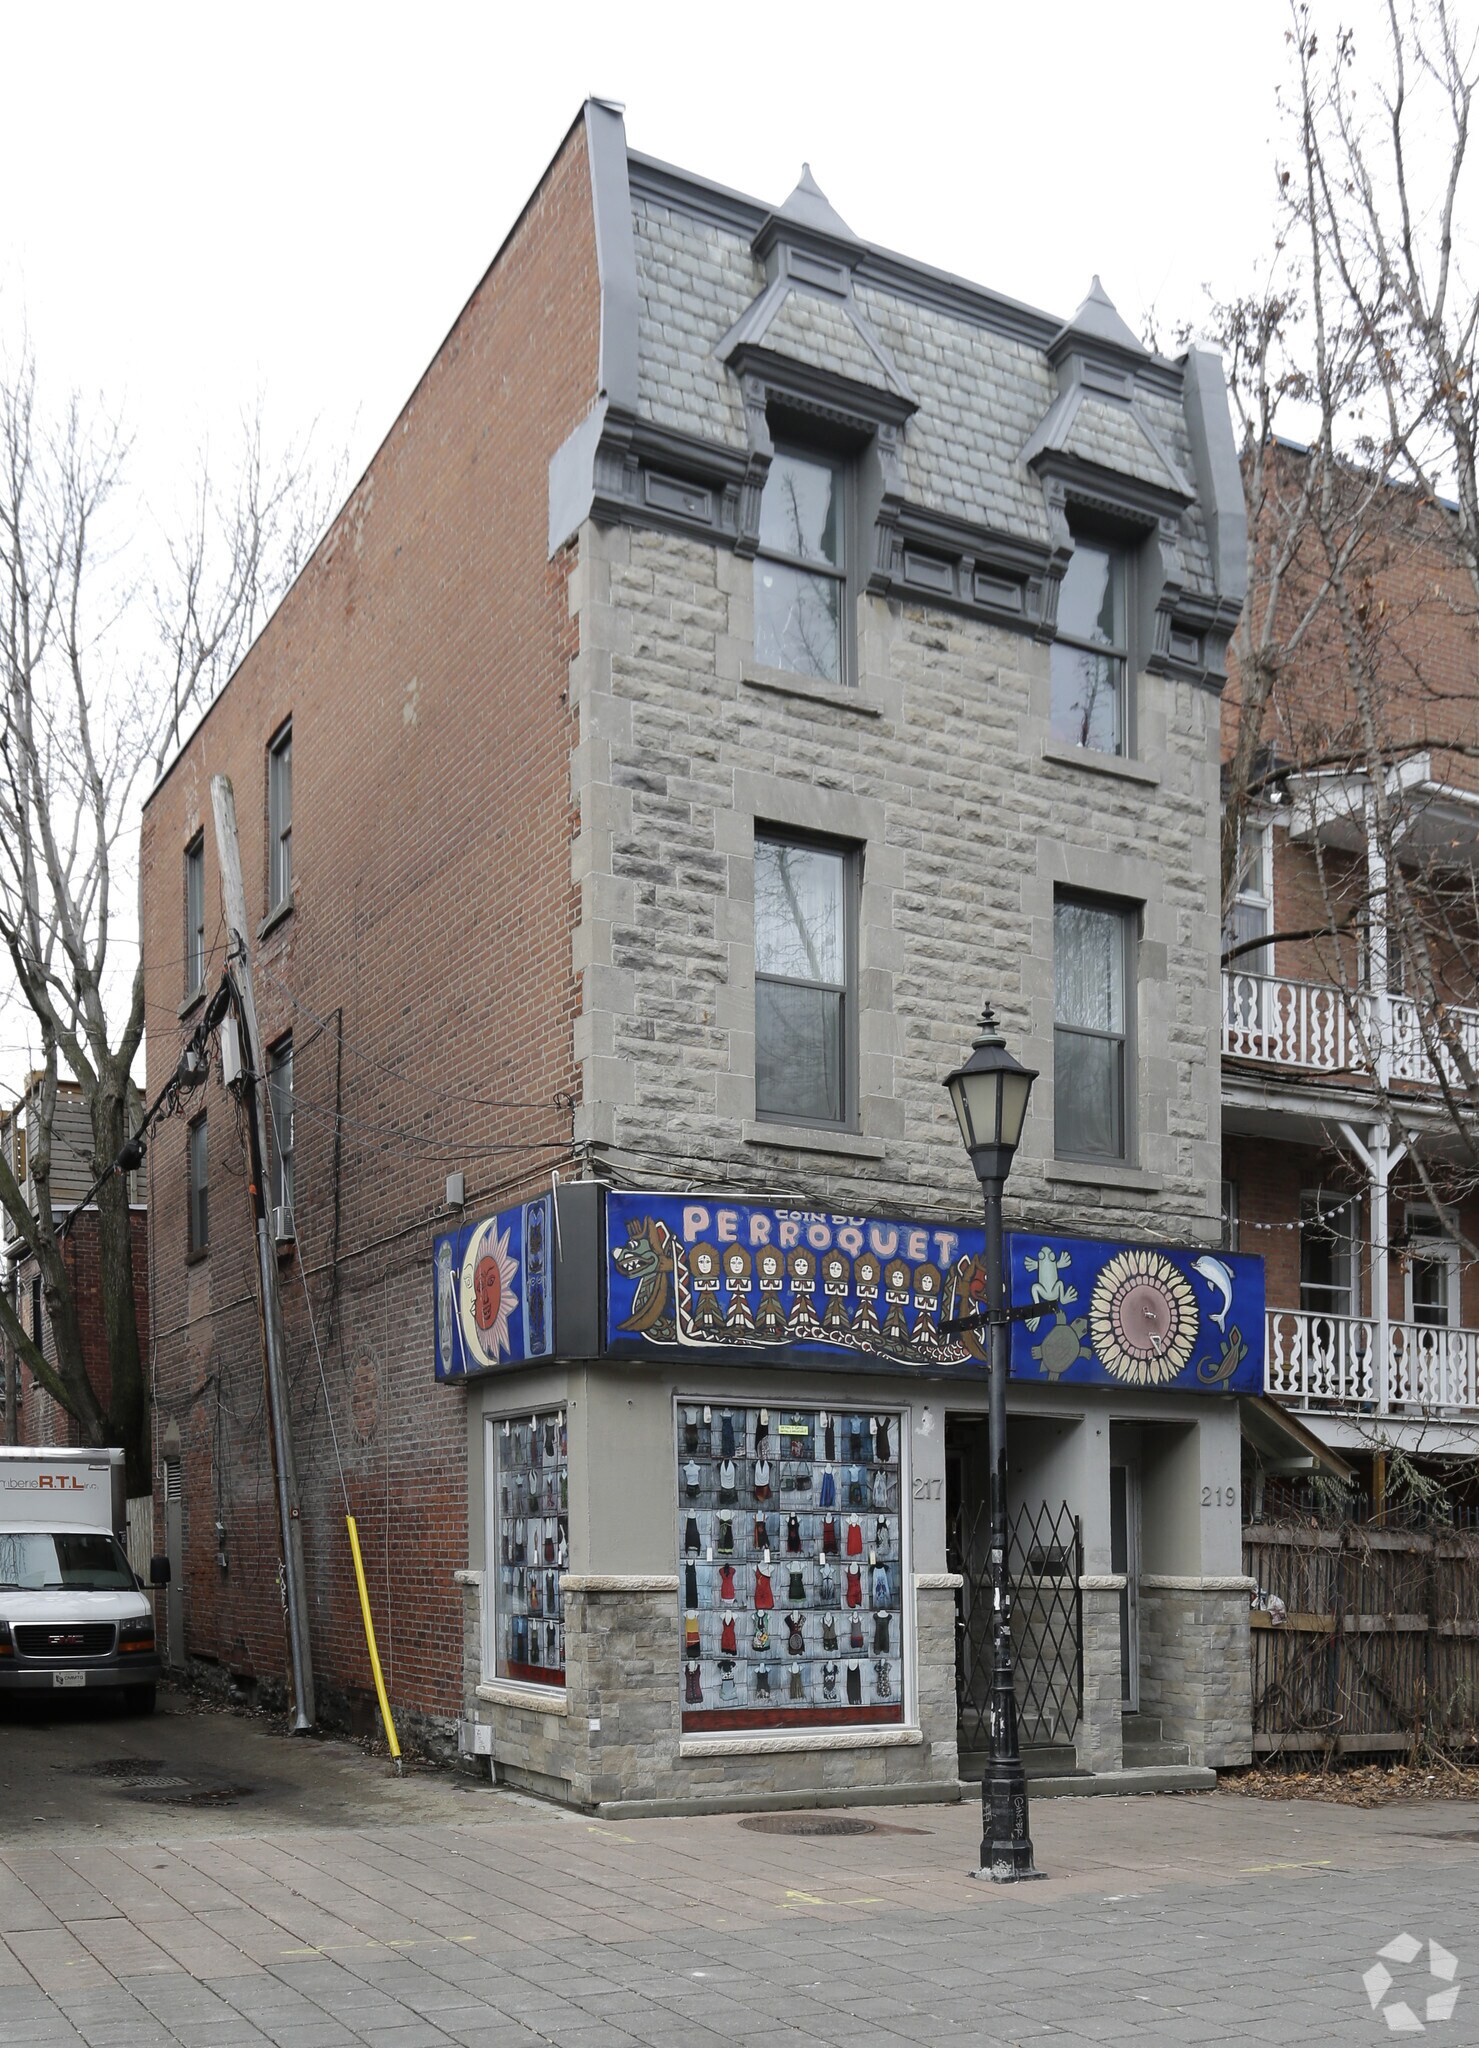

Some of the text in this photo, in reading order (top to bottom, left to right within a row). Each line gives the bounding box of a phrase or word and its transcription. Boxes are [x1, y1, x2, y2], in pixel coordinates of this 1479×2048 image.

[775, 1209, 866, 1226] COIN DU
[682, 1206, 956, 1265] PERROQUET
[913, 1477, 943, 1500] 217
[1201, 1486, 1235, 1507] 219
[48, 1635, 84, 1644] GMC
